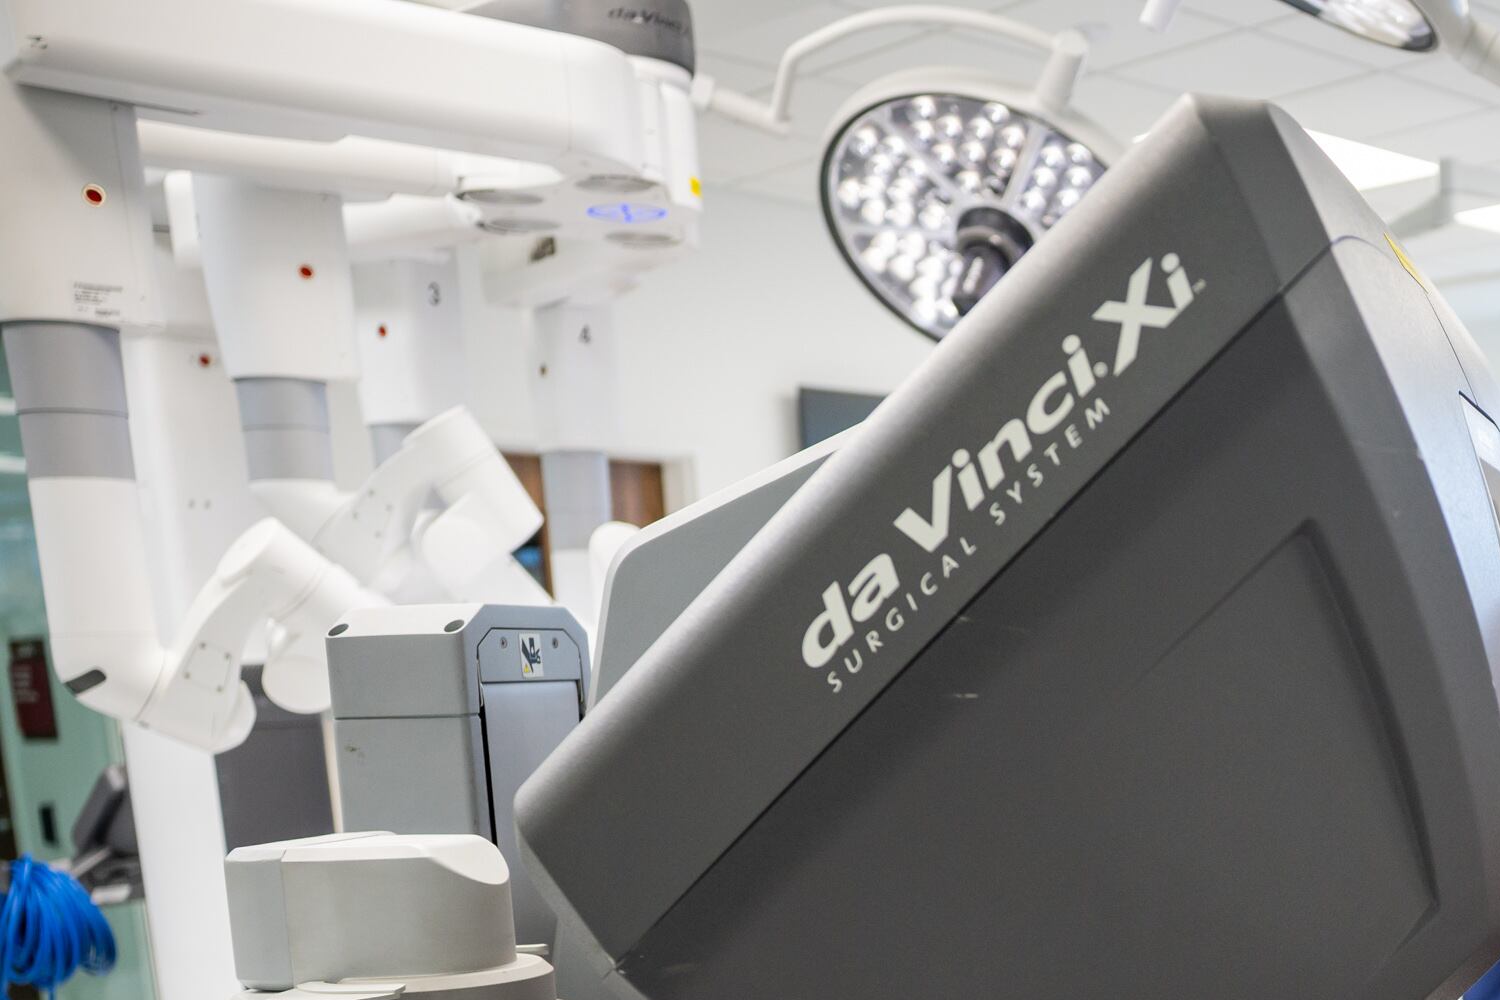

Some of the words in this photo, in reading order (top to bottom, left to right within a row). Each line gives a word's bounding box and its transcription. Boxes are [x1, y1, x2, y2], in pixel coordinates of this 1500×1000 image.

[428, 281, 441, 306] 3
[827, 536, 977, 694] SURGICAL
[989, 397, 1111, 526] SYSTEM
[801, 552, 900, 668] da
